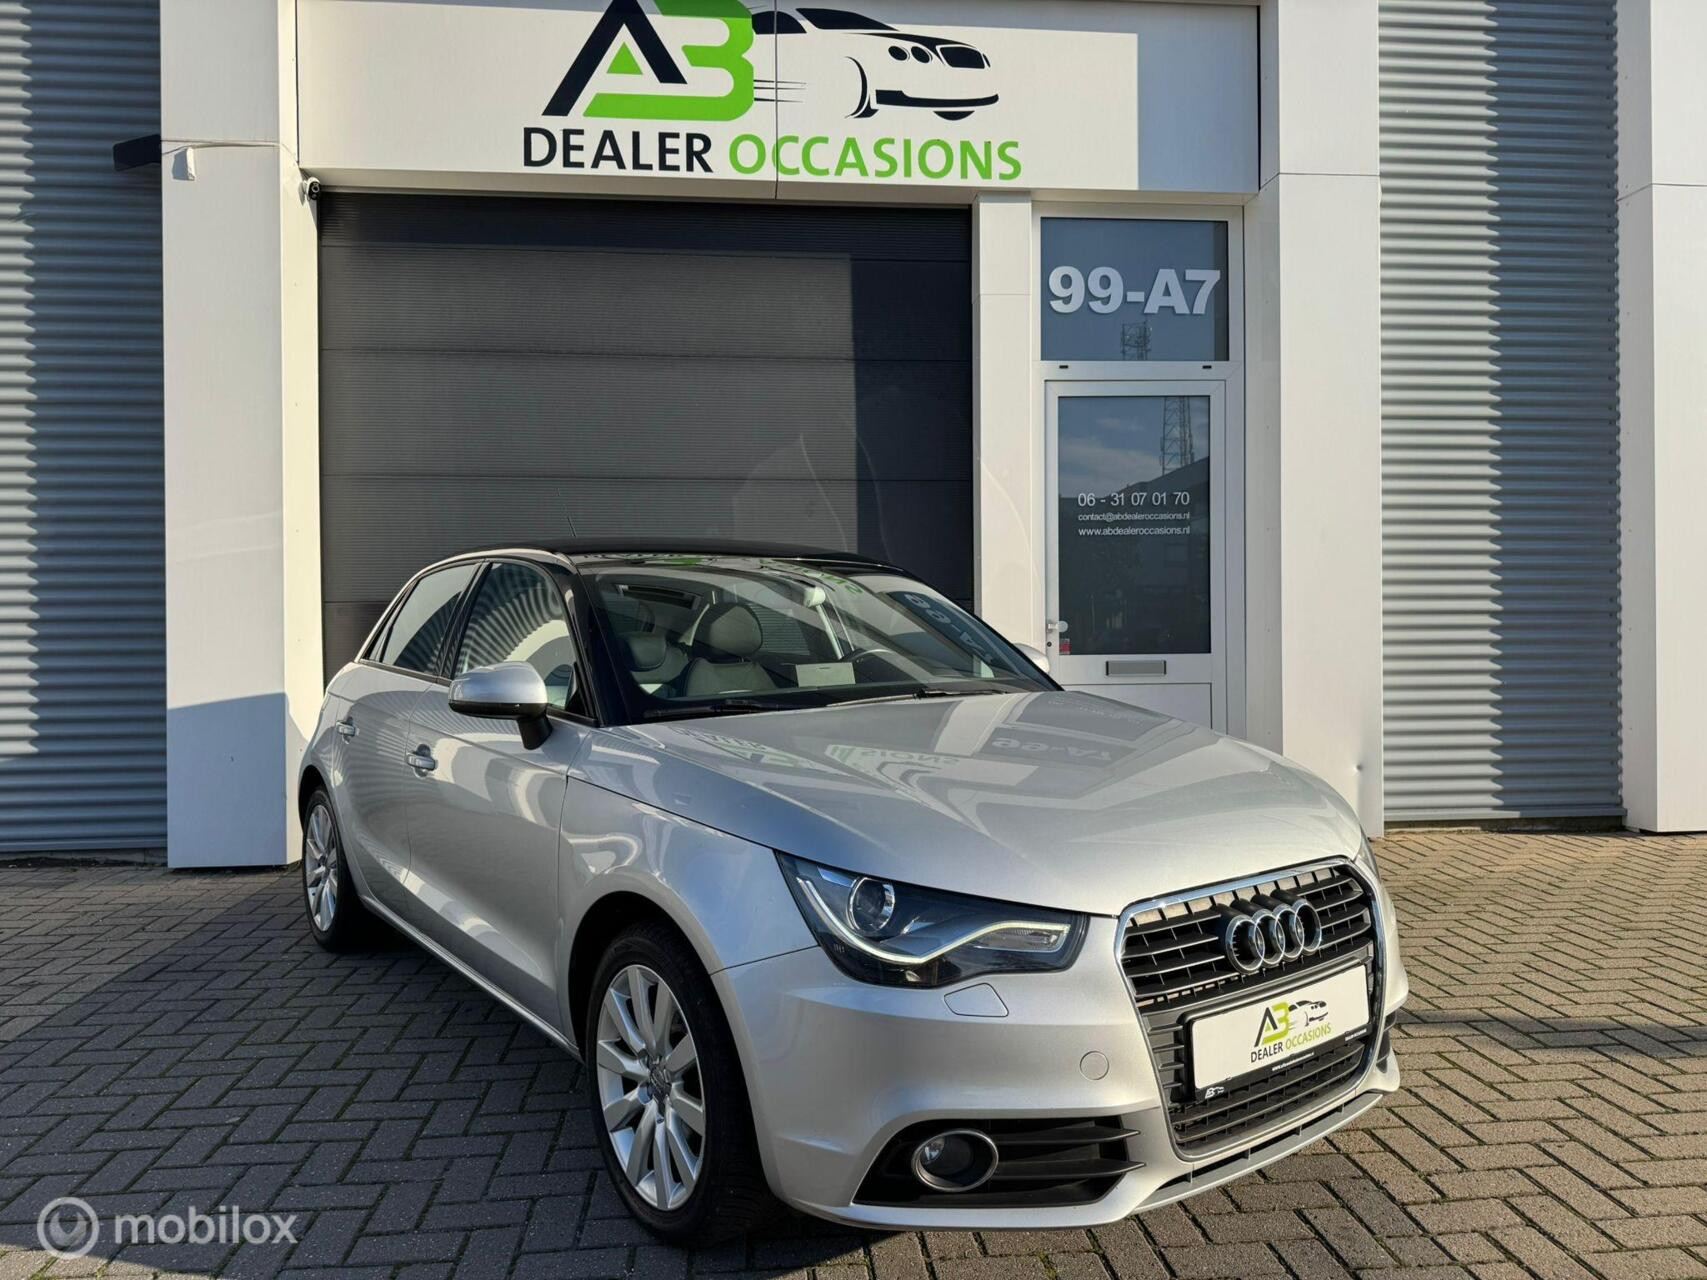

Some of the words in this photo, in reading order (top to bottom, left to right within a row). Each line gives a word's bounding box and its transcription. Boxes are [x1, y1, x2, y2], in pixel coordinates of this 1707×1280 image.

[522, 126, 713, 174] DEALER
[728, 133, 1022, 181] OCCASIONS
[1048, 265, 1221, 315] 99-A7
[1077, 492, 1096, 507] 06
[1110, 492, 1125, 506] 31
[1130, 492, 1147, 506] 07
[1151, 491, 1167, 506] 01
[1172, 491, 1190, 505] 70
[1078, 511, 1190, 523] contact@abdealeroccasions.nl
[1078, 526, 1191, 536] www.abdealeroccasions.nl
[1250, 1041, 1284, 1063] DEALER
[1285, 1022, 1332, 1051] OCCASIONS
